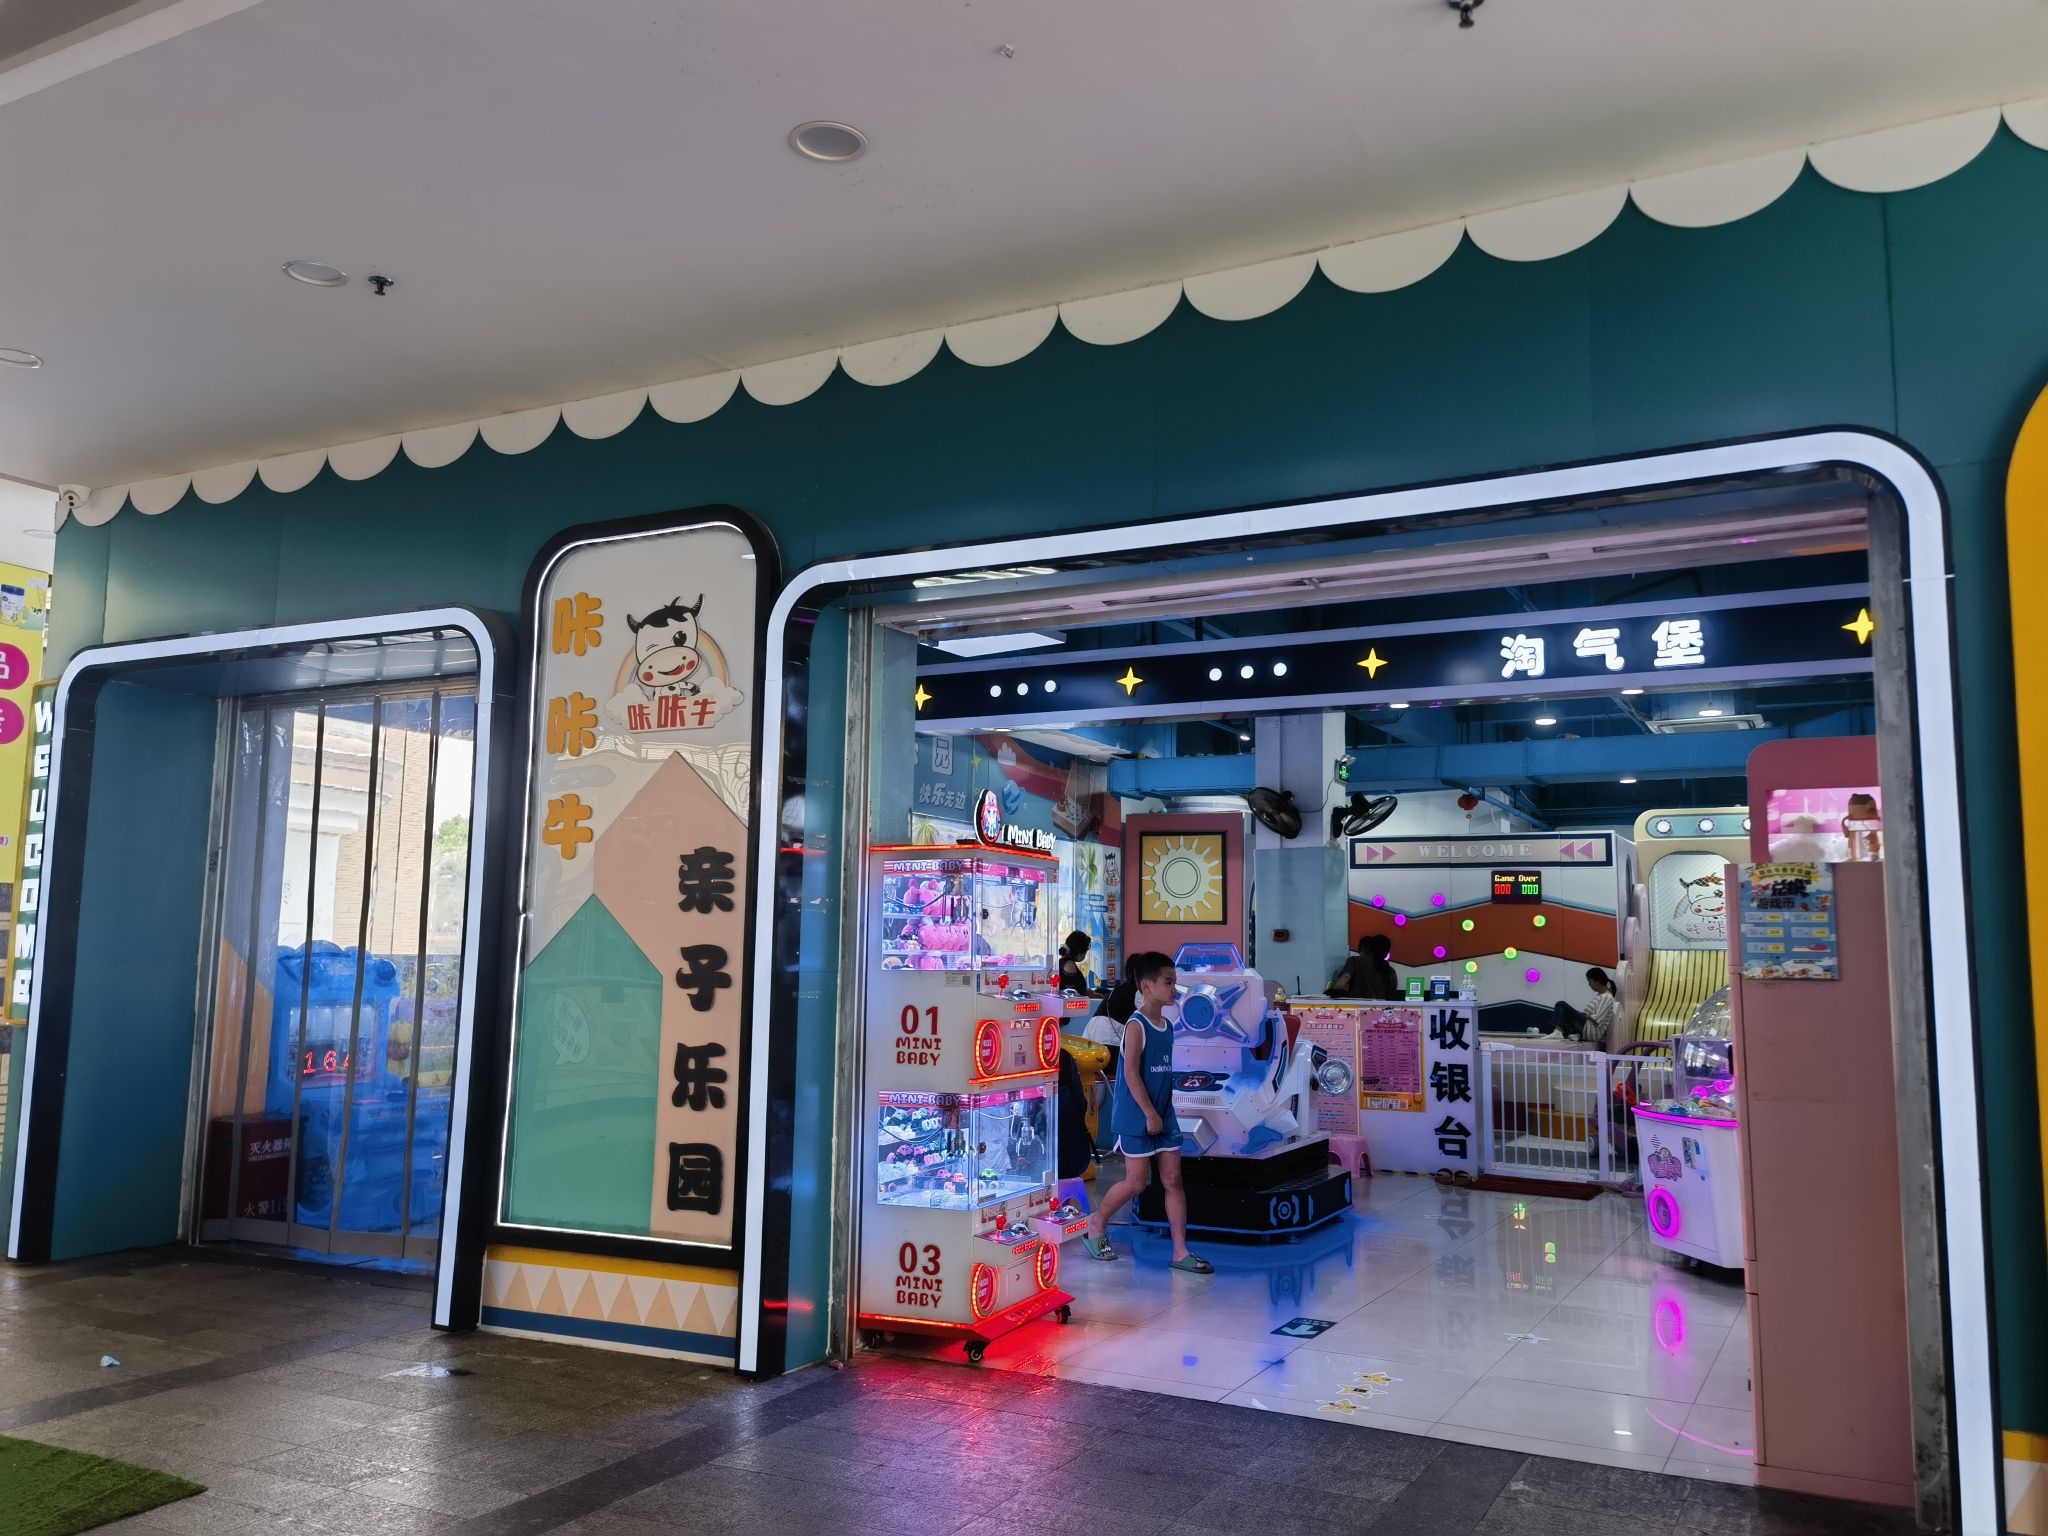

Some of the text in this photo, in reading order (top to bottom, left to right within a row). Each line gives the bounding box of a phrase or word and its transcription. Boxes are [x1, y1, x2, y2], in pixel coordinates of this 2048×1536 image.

[1500, 620, 1705, 678] 淘气堡
[627, 694, 717, 731] 咔咔牛
[542, 592, 603, 859] 咔咔牛
[919, 783, 967, 810] 快乐无边
[1008, 824, 1034, 846] MINI
[1417, 843, 1533, 858] WELCOME
[893, 860, 964, 872] MINI BABY
[1518, 874, 1539, 882] Over
[667, 847, 736, 1214] 亲子乐园
[901, 1004, 939, 1036] 01
[895, 1037, 942, 1050] MINI
[896, 1051, 941, 1066] BABY
[1429, 1009, 1473, 1160] 收银台
[889, 1093, 962, 1106] MINI BABY
[899, 1242, 941, 1276] 03
[895, 1276, 943, 1291] MINI
[896, 1291, 943, 1308] BABY
